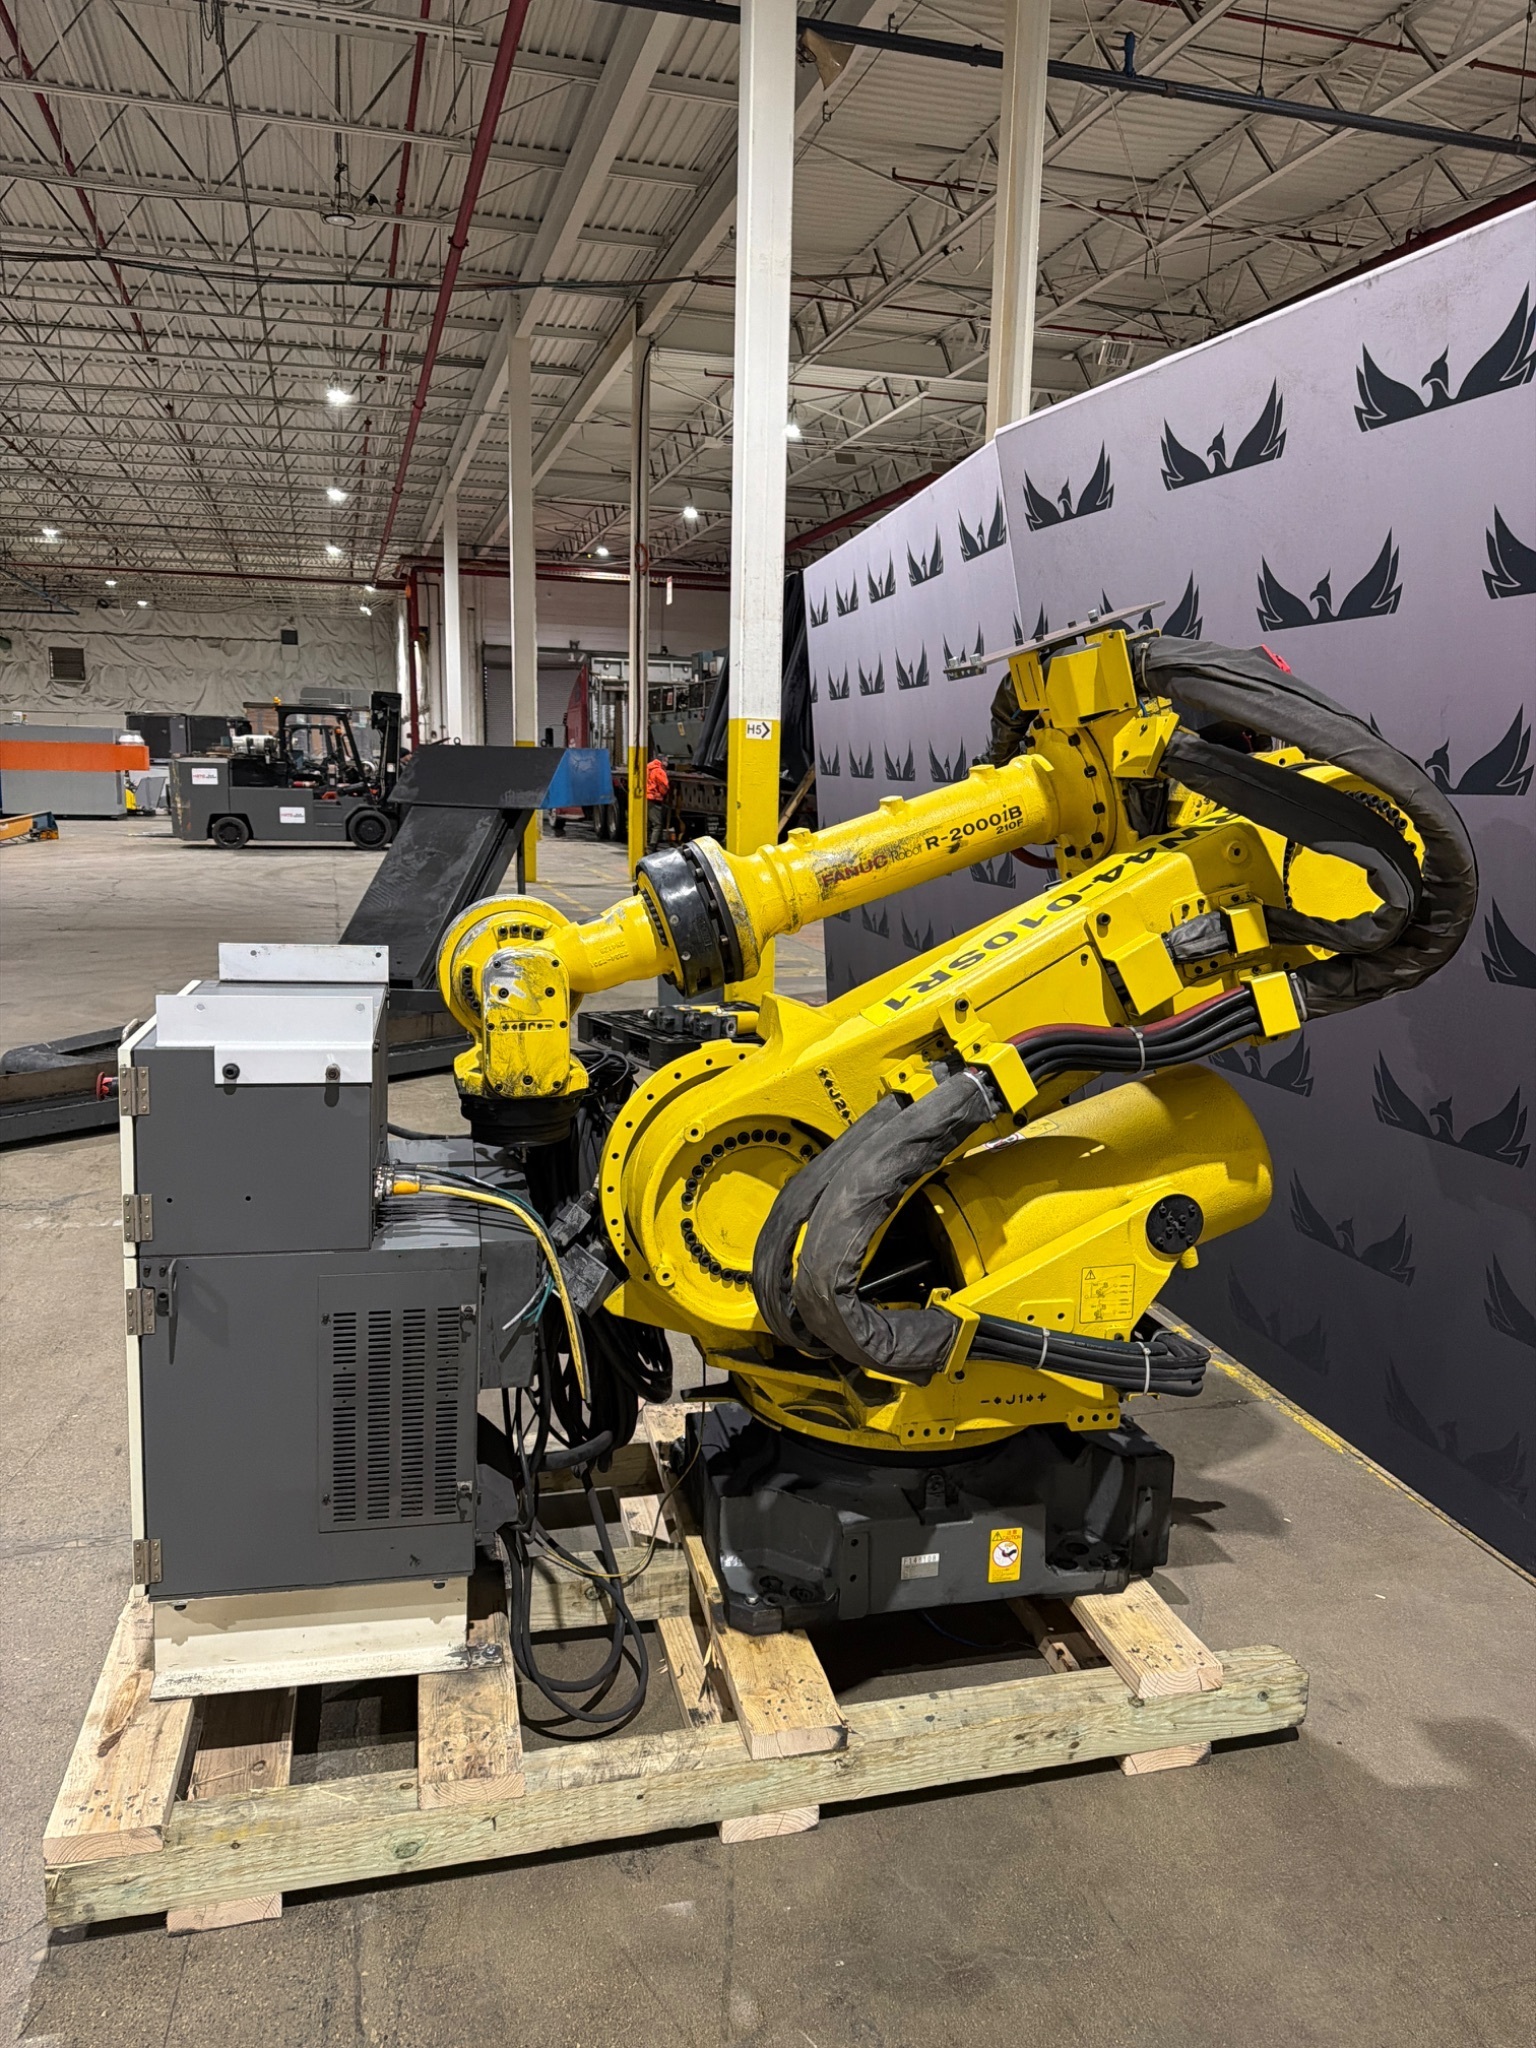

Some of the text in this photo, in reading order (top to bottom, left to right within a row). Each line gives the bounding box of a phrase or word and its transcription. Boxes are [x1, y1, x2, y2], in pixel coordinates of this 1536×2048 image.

[821, 803, 1023, 888] FANUC Robot R-2000iB
[996, 818, 1024, 836] 210F
